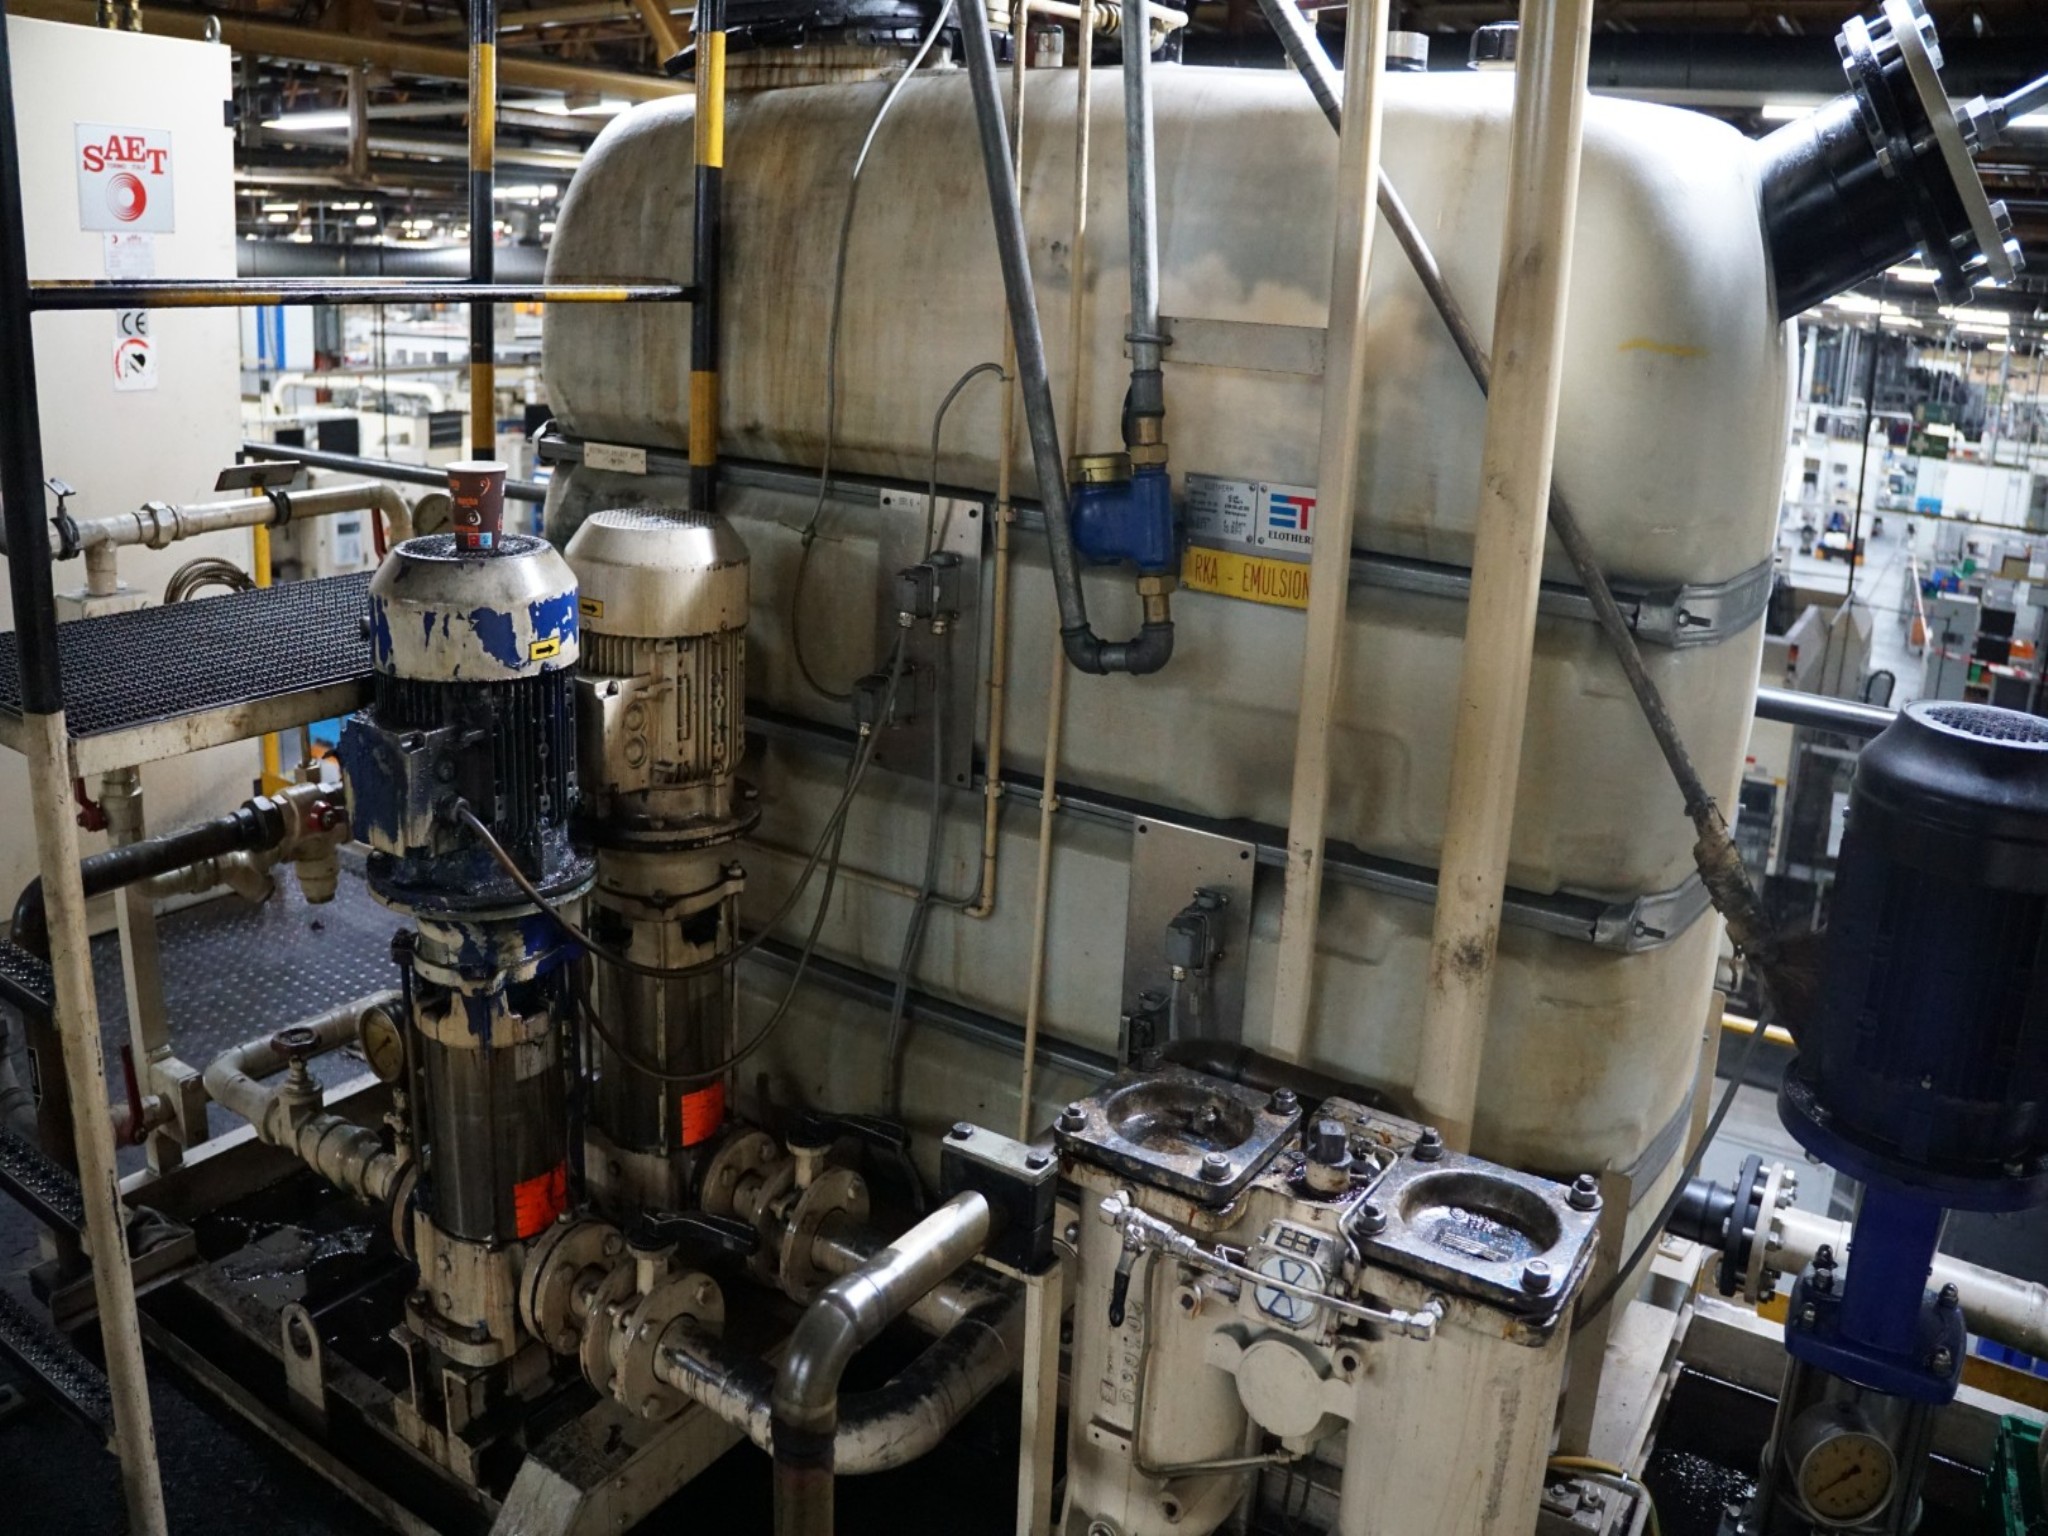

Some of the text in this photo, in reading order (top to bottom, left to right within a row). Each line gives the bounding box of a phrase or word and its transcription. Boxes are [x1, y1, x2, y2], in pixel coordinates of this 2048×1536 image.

[83, 135, 167, 175] SAET
[122, 312, 145, 335] CE
[1195, 554, 1218, 585] RKA
